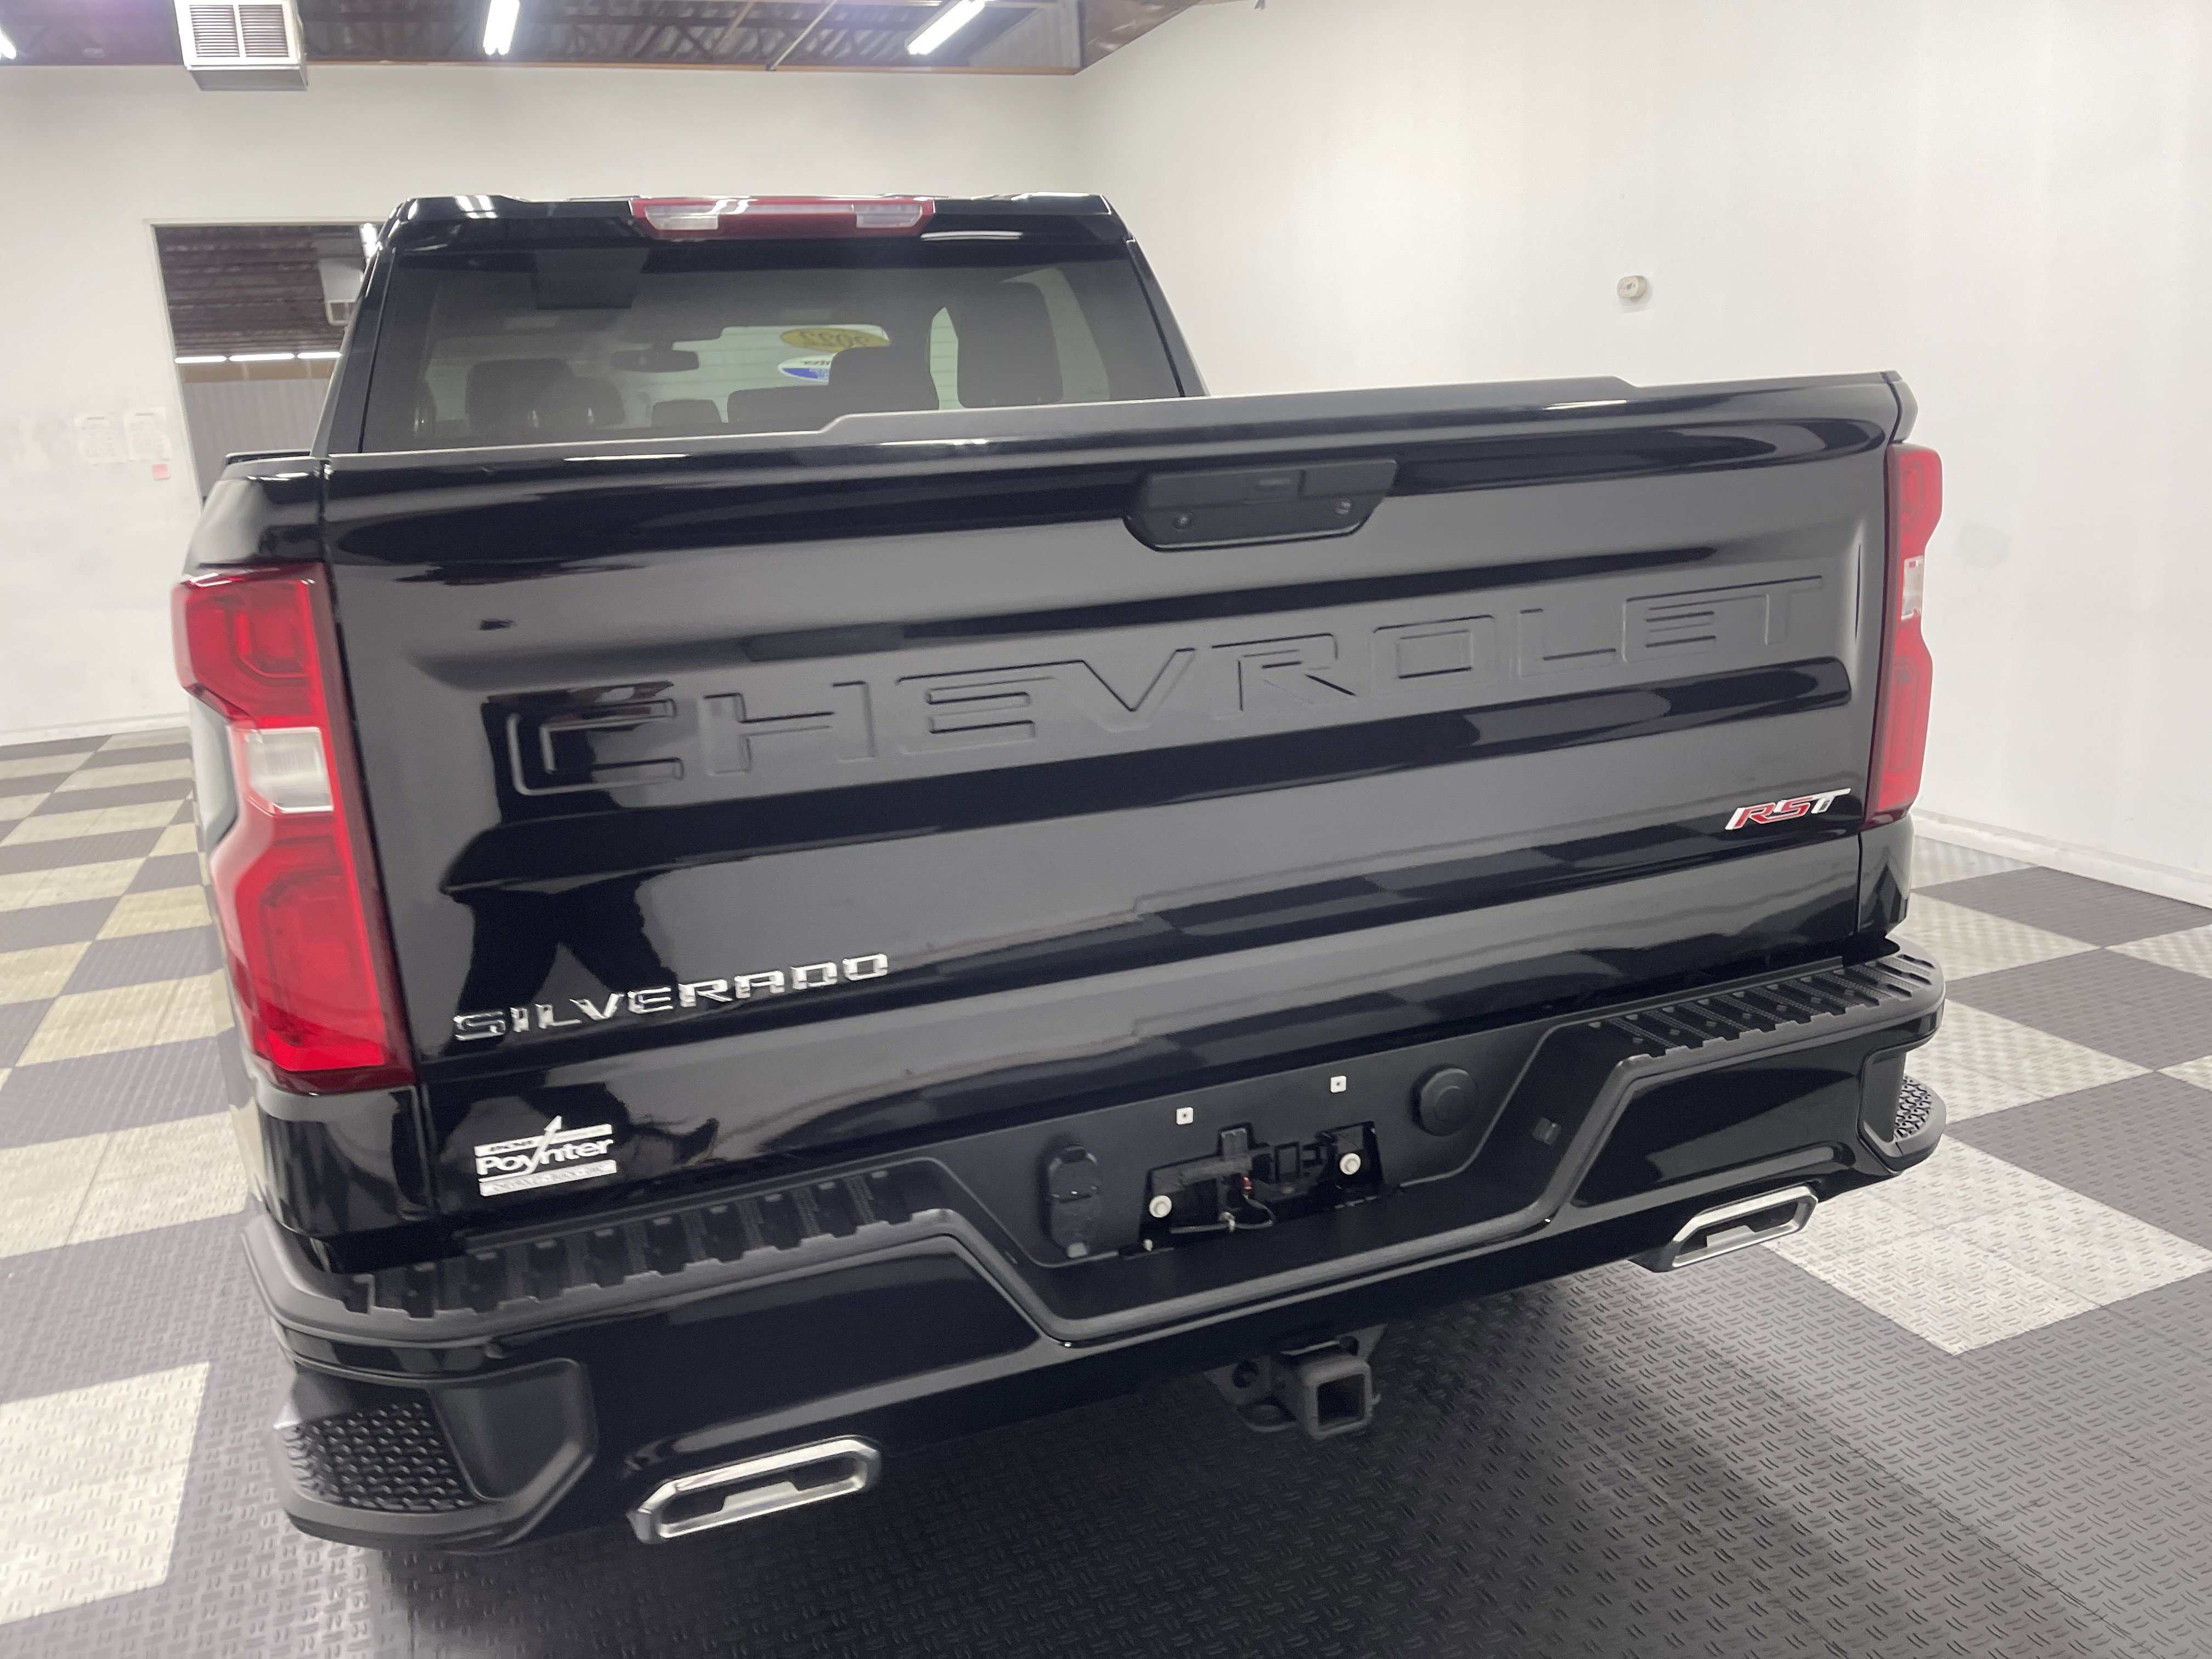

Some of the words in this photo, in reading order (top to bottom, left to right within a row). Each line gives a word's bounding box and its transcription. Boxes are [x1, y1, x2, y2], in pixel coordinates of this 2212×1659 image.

[506, 574, 1822, 795] CHEVROLET
[1724, 787, 1852, 831] RST
[453, 953, 889, 1041] SILVERADO
[475, 1138, 614, 1178] Poynter
